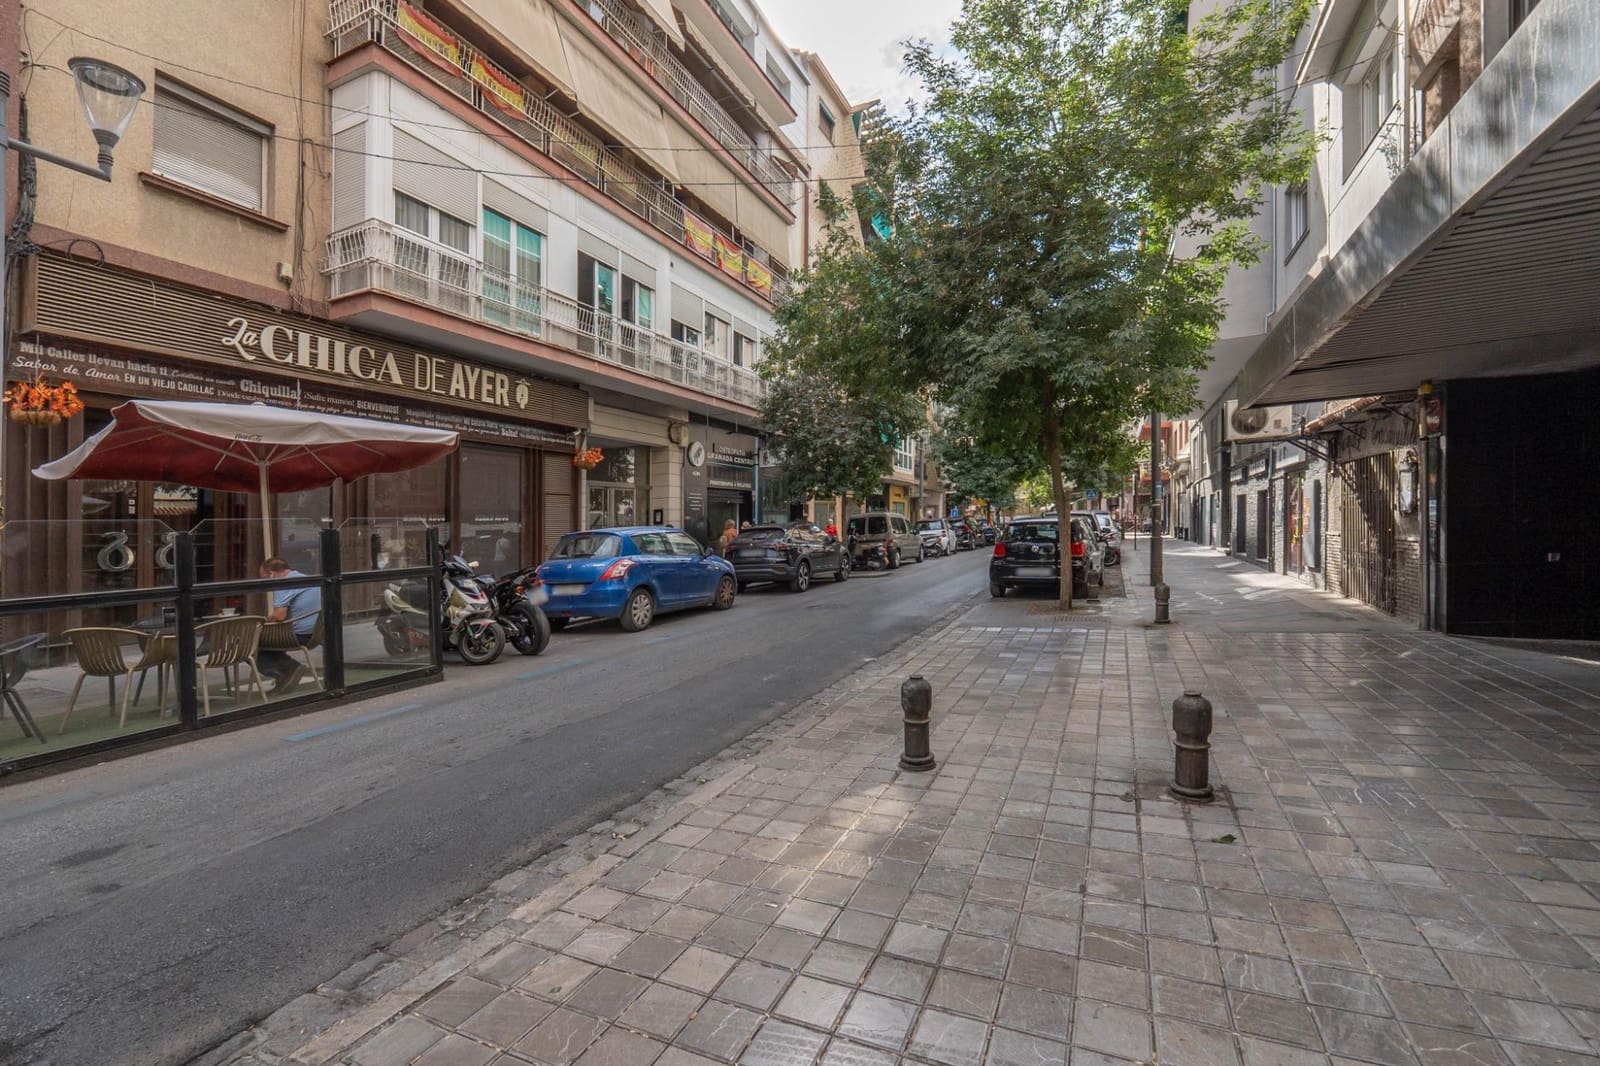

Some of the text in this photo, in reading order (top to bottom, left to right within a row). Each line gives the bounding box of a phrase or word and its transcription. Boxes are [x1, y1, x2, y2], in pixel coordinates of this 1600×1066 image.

[12, 355, 121, 382] Sabor de Amor
[47, 346, 85, 362] Calles
[88, 353, 125, 369] llevan
[127, 360, 157, 374] hacia
[221, 317, 510, 407] La CHICA DE AYER
[124, 372, 215, 396] EN UN VIEJO CADILLAC
